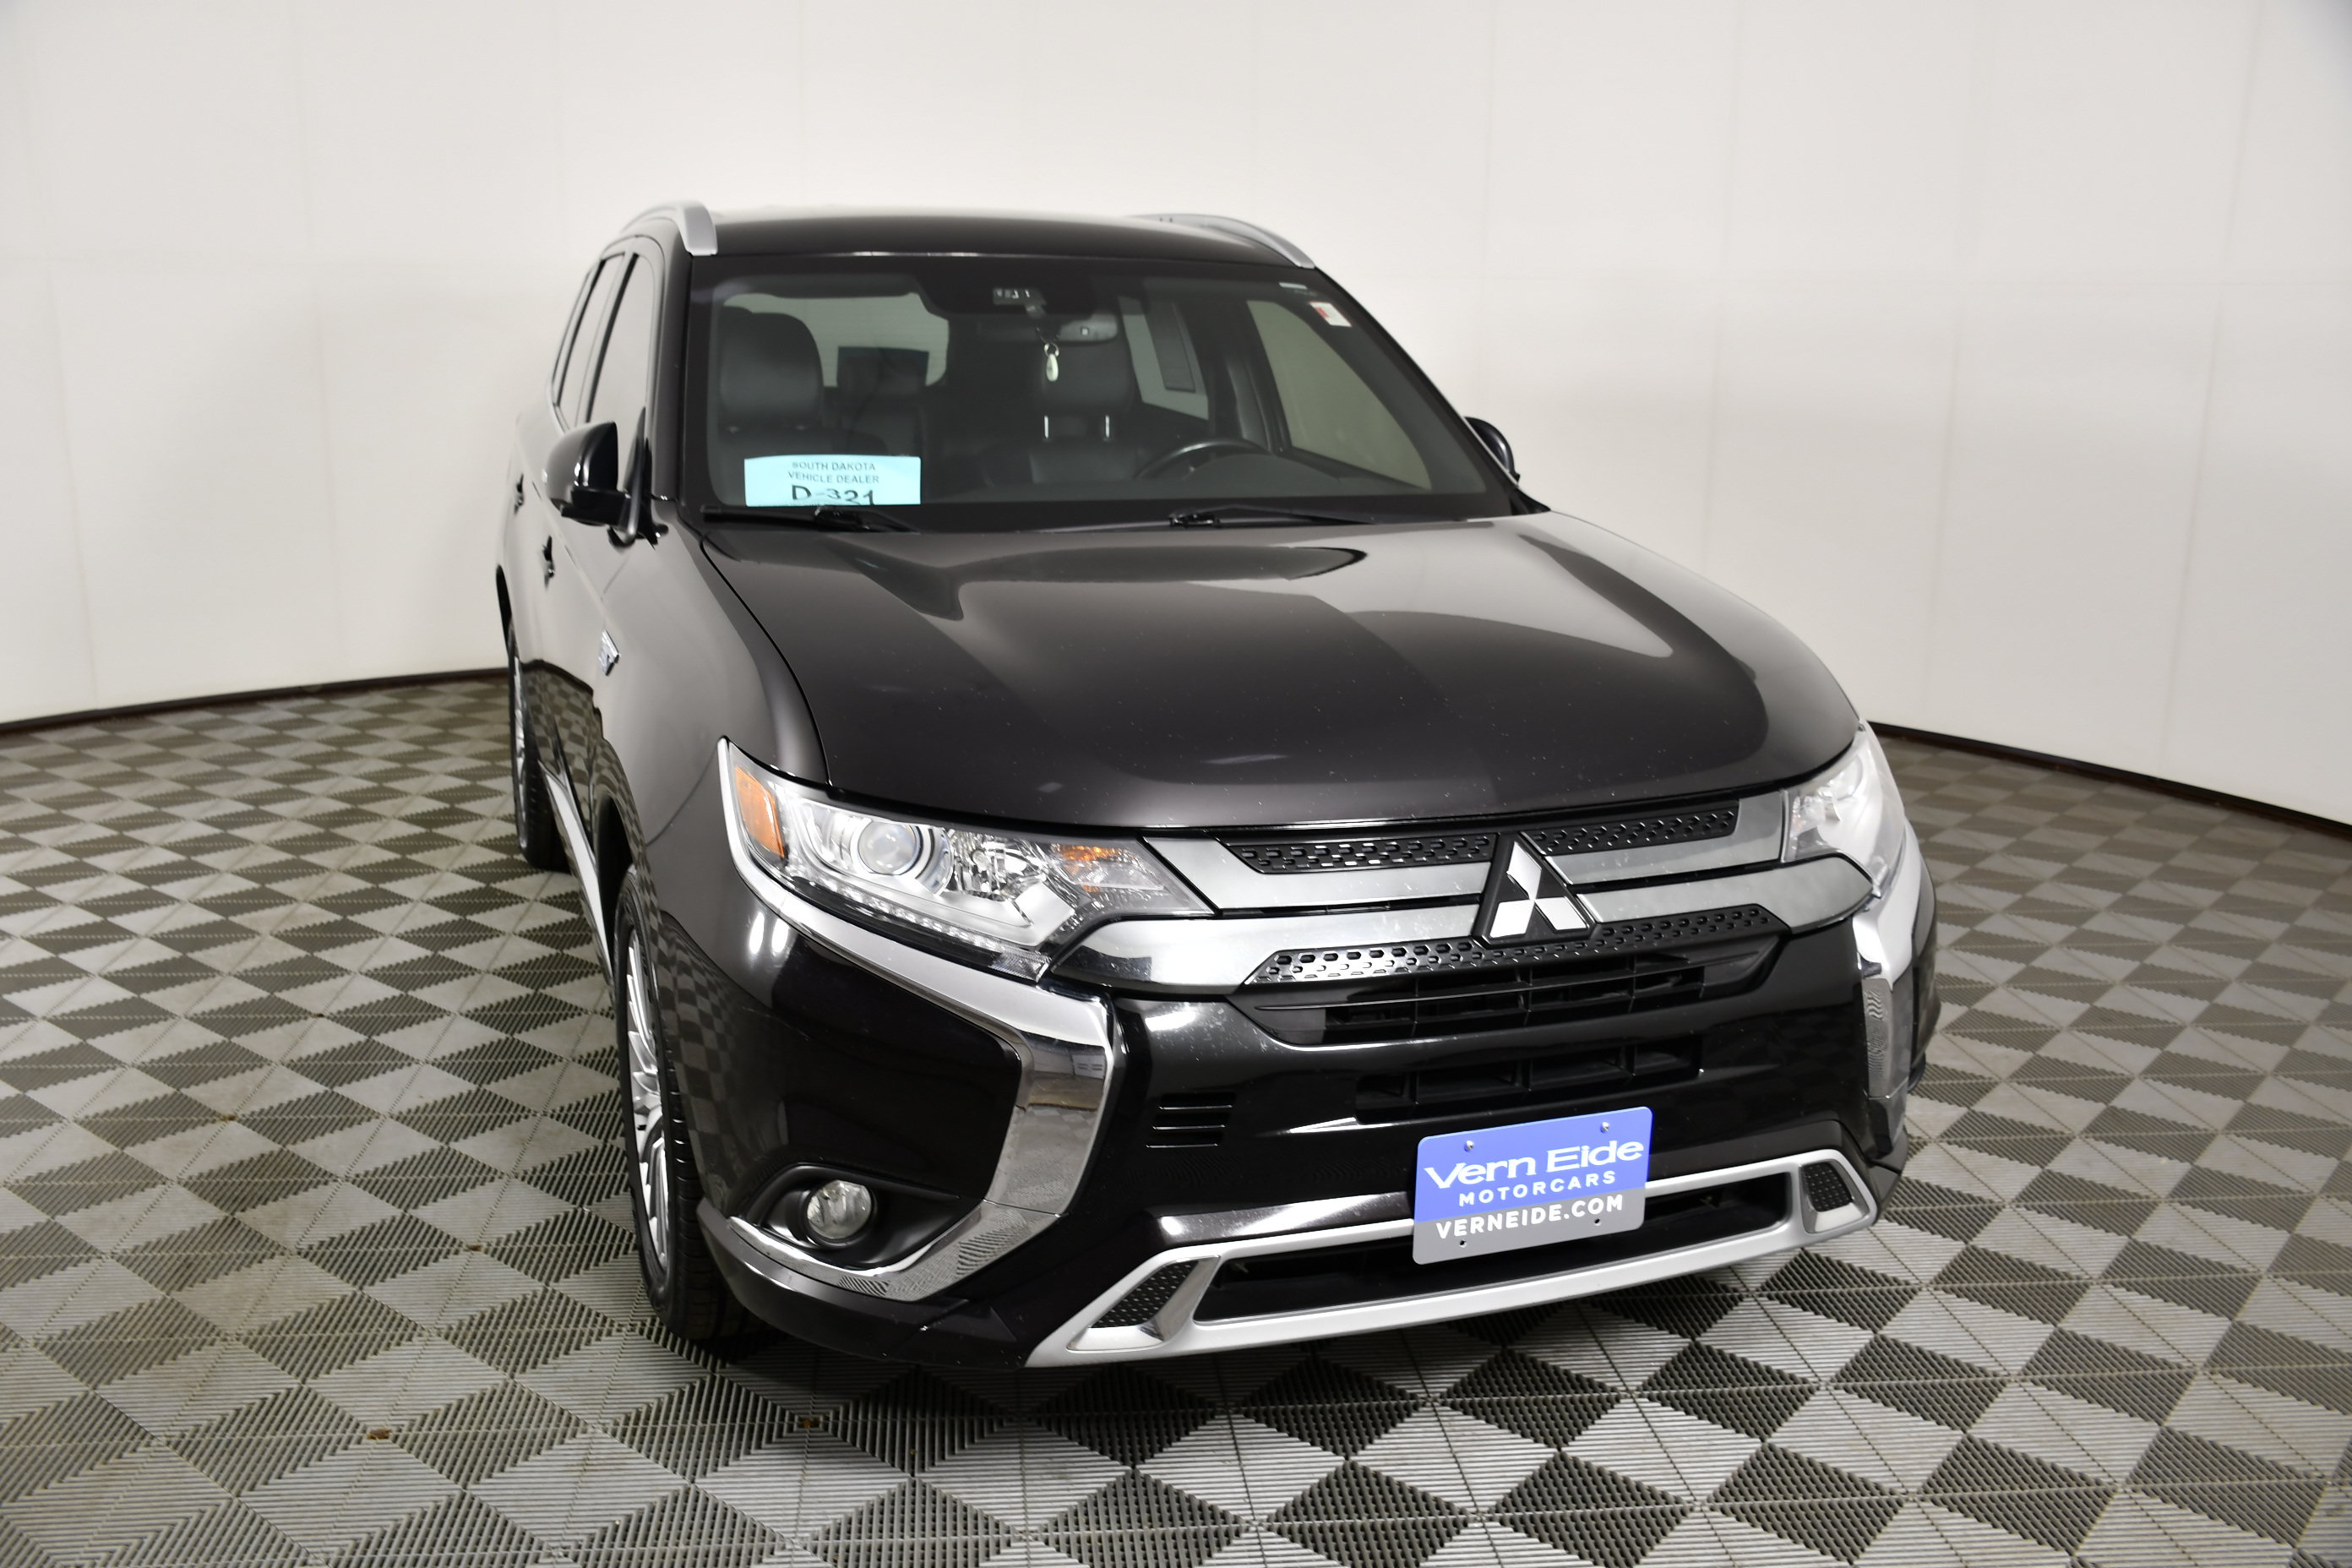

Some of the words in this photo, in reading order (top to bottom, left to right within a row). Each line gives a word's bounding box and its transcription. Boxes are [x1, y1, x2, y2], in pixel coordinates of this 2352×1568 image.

[788, 471, 833, 482] VEHICLE
[836, 474, 879, 483] DEALER
[792, 461, 828, 471] SOUTH
[832, 462, 875, 471] DAKOTA
[792, 485, 874, 505] D-321
[1424, 1156, 1537, 1190] Vern
[1546, 1140, 1644, 1172] Eide
[1458, 1170, 1616, 1207] MOTORCARS
[1435, 1194, 1624, 1239] VERNEIDE.COM
